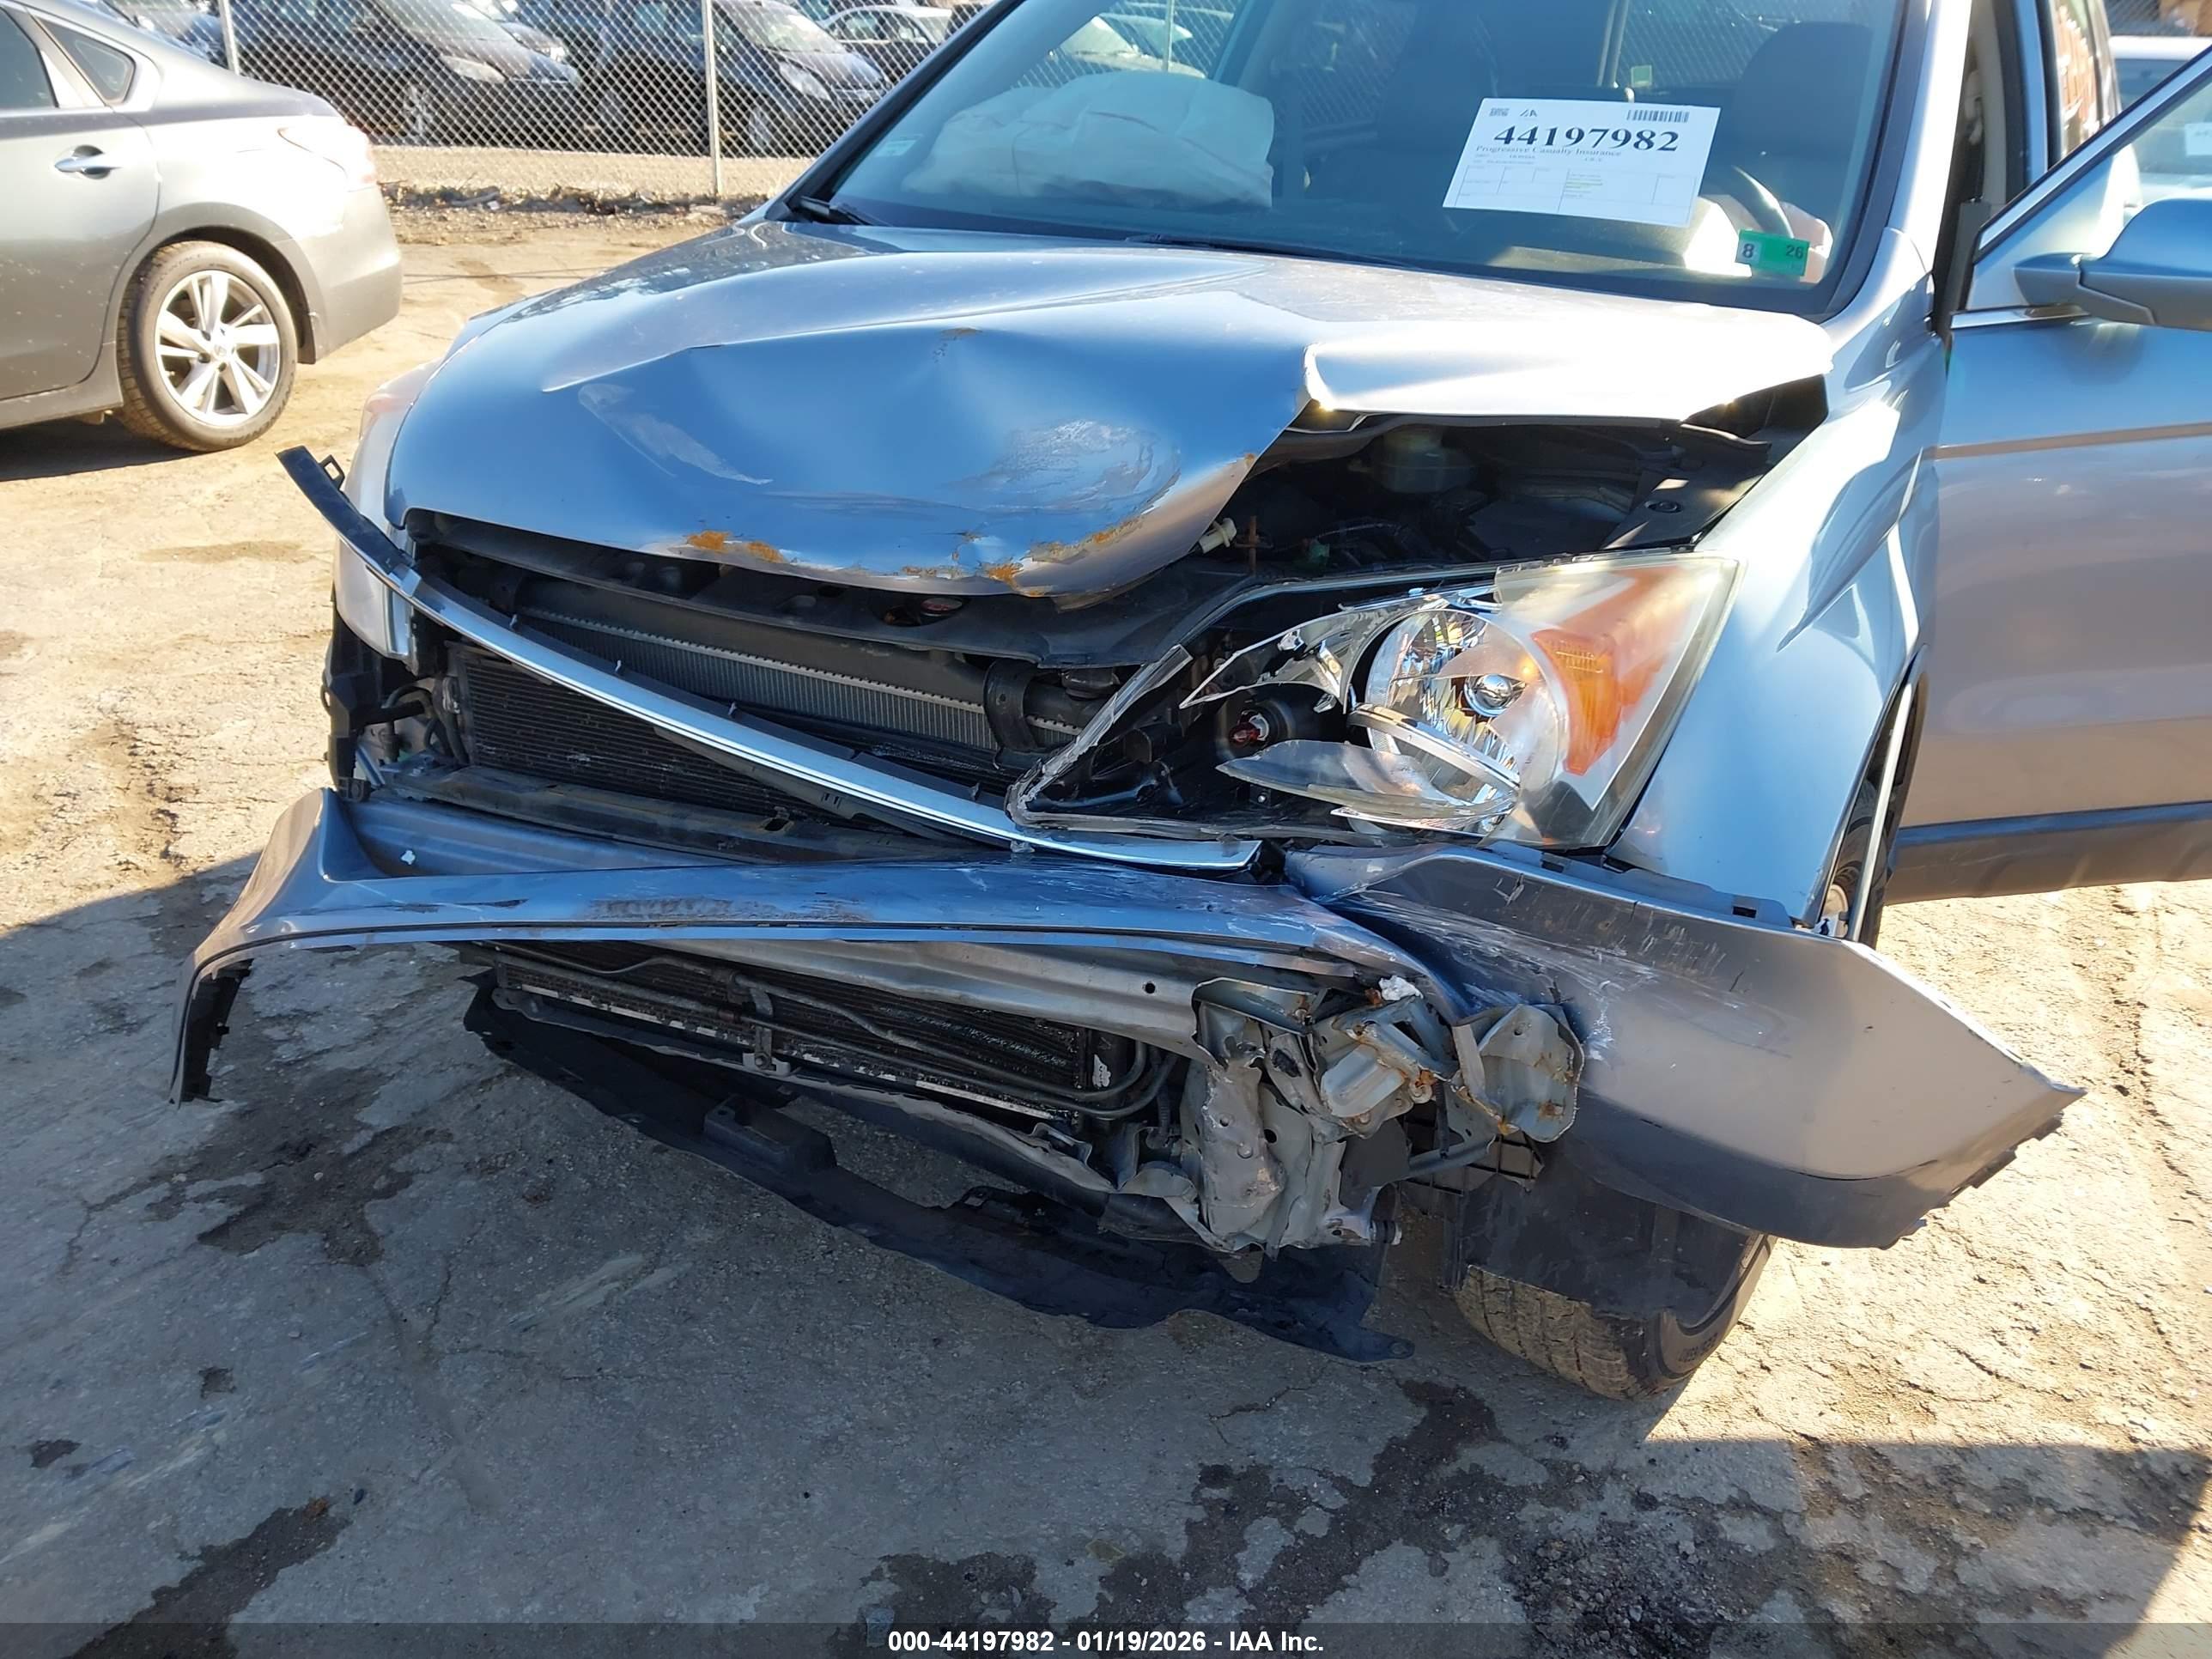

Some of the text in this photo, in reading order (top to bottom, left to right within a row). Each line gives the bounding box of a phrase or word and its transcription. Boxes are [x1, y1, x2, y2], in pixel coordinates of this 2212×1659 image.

[1494, 125, 1679, 151] 44197982
[1533, 147, 1572, 155] Casualty
[1742, 243, 1803, 259] 8 26
